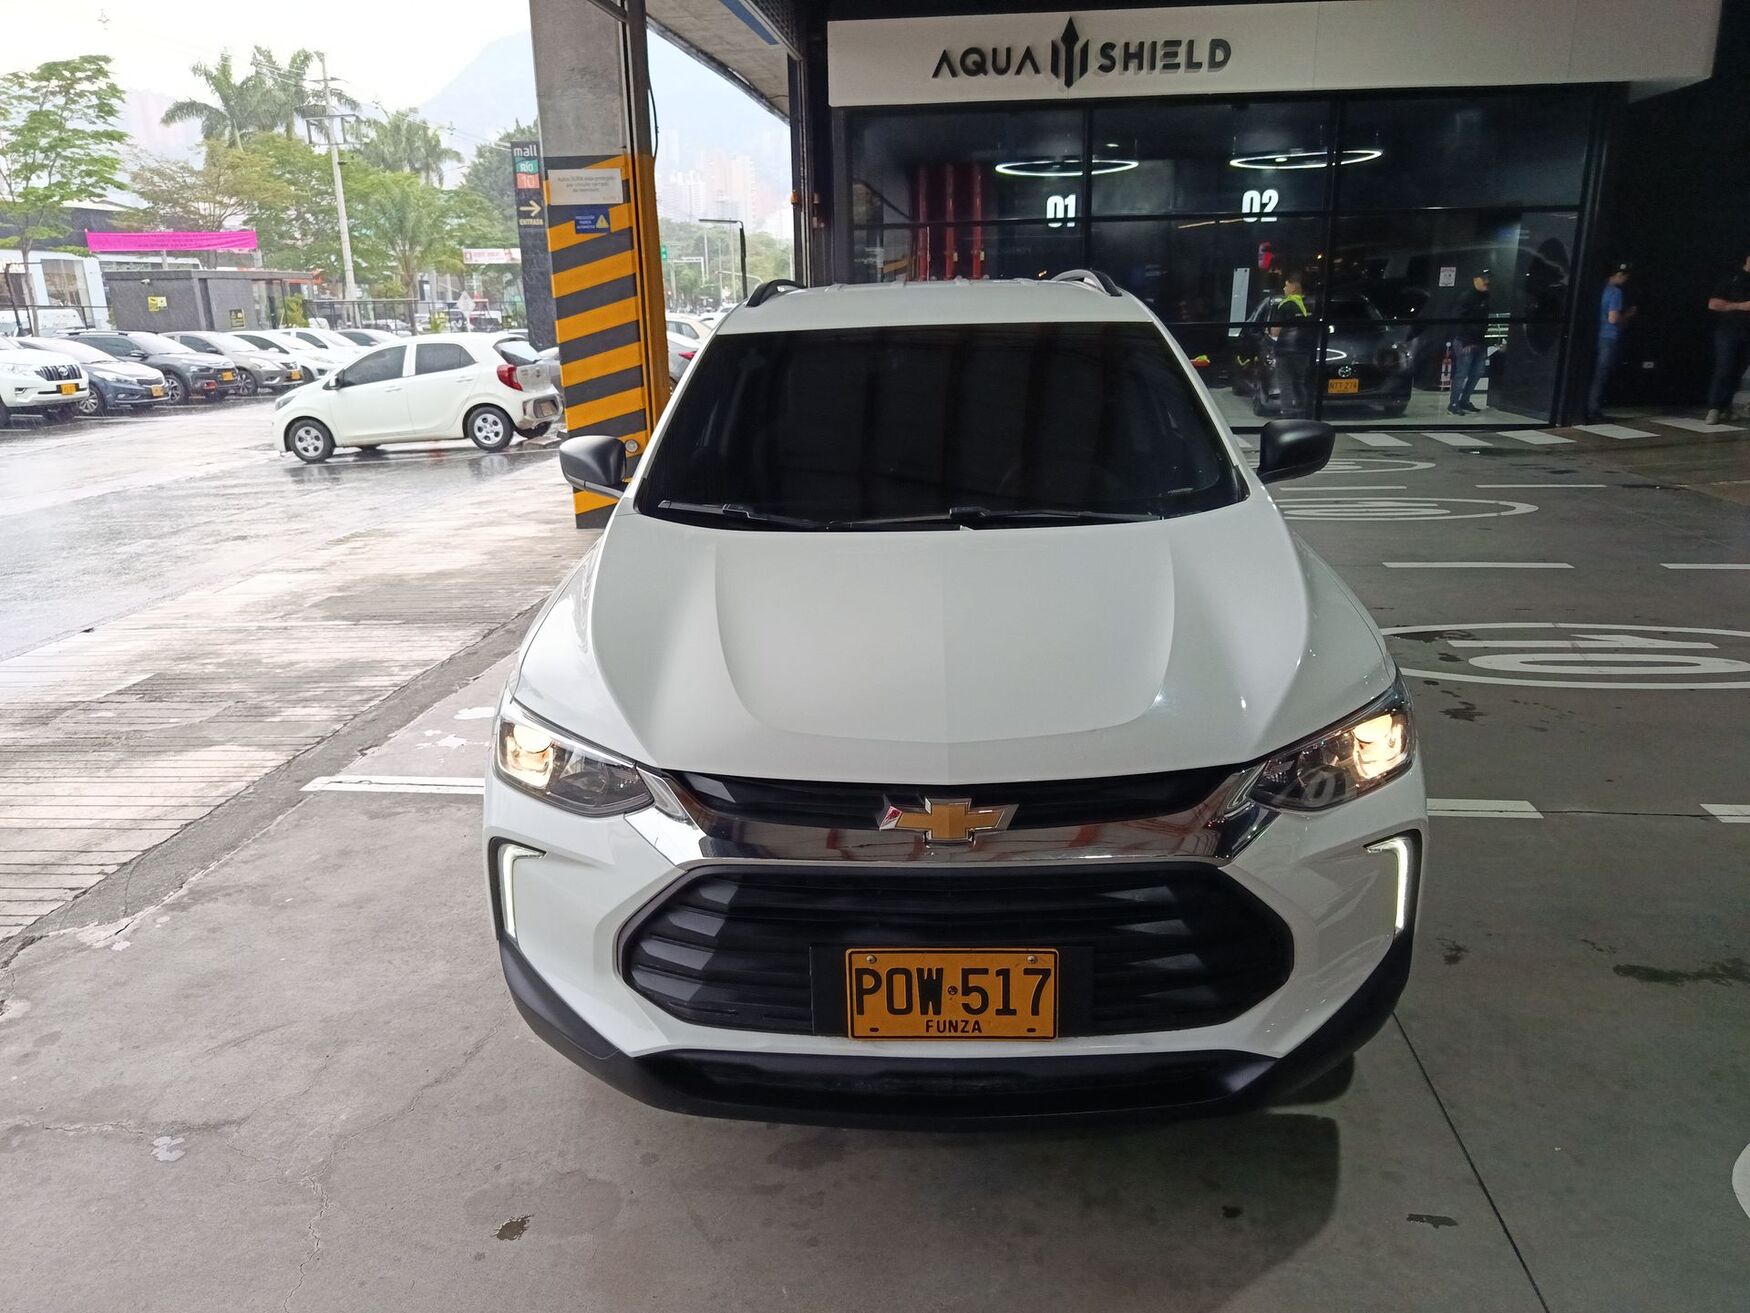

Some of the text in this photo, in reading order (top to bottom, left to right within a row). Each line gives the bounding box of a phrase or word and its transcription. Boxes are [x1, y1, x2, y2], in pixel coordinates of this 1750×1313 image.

[932, 38, 1232, 79] AQUA SHIELD
[513, 144, 537, 156] mall
[1046, 194, 1077, 227] 01
[1242, 189, 1279, 223] 02
[925, 1019, 983, 1034] FUNZA
